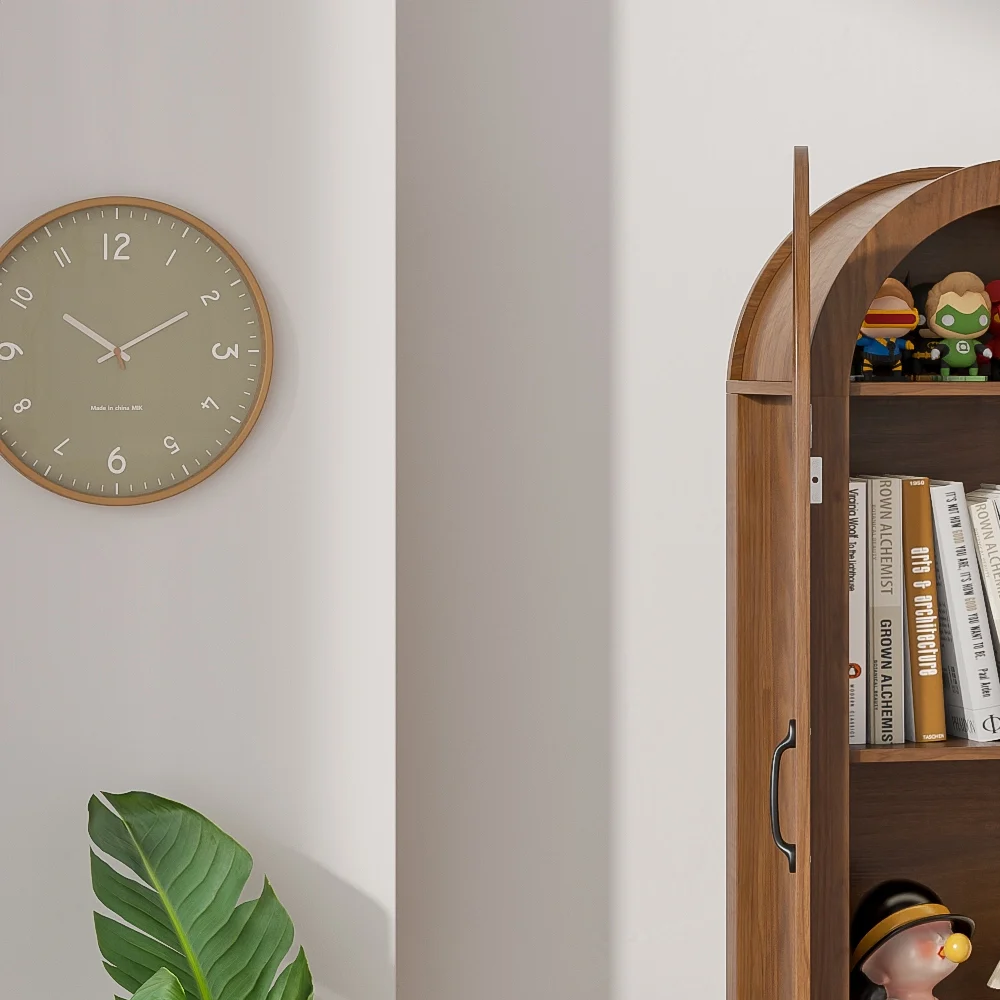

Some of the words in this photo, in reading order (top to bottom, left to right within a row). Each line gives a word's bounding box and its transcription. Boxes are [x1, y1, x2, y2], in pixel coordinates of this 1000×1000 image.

[103, 232, 131, 260] 12
[10, 287, 33, 309] 10
[200, 290, 220, 306] 2
[211, 342, 239, 360] 3
[13, 398, 31, 413] 8
[200, 396, 220, 410] 4
[53, 438, 70, 456] 7
[163, 435, 180, 455] 5
[107, 446, 126, 474] 6
[880, 480, 893, 520] ROWN
[947, 503, 959, 514] NOT
[950, 516, 962, 528] HOW
[975, 503, 994, 540] ROWN
[880, 523, 893, 595] ALCHEMIST
[911, 546, 932, 573] arts
[955, 545, 967, 557] YOU
[913, 580, 931, 589] &
[962, 583, 974, 595] HOW
[967, 613, 979, 625] YOU
[914, 595, 938, 676] architecture
[970, 625, 983, 640] WANT
[880, 619, 893, 669] GROWN
[977, 668, 989, 680] Paul
[980, 682, 992, 698] Arden
[881, 674, 893, 744] ALCHEMIS
